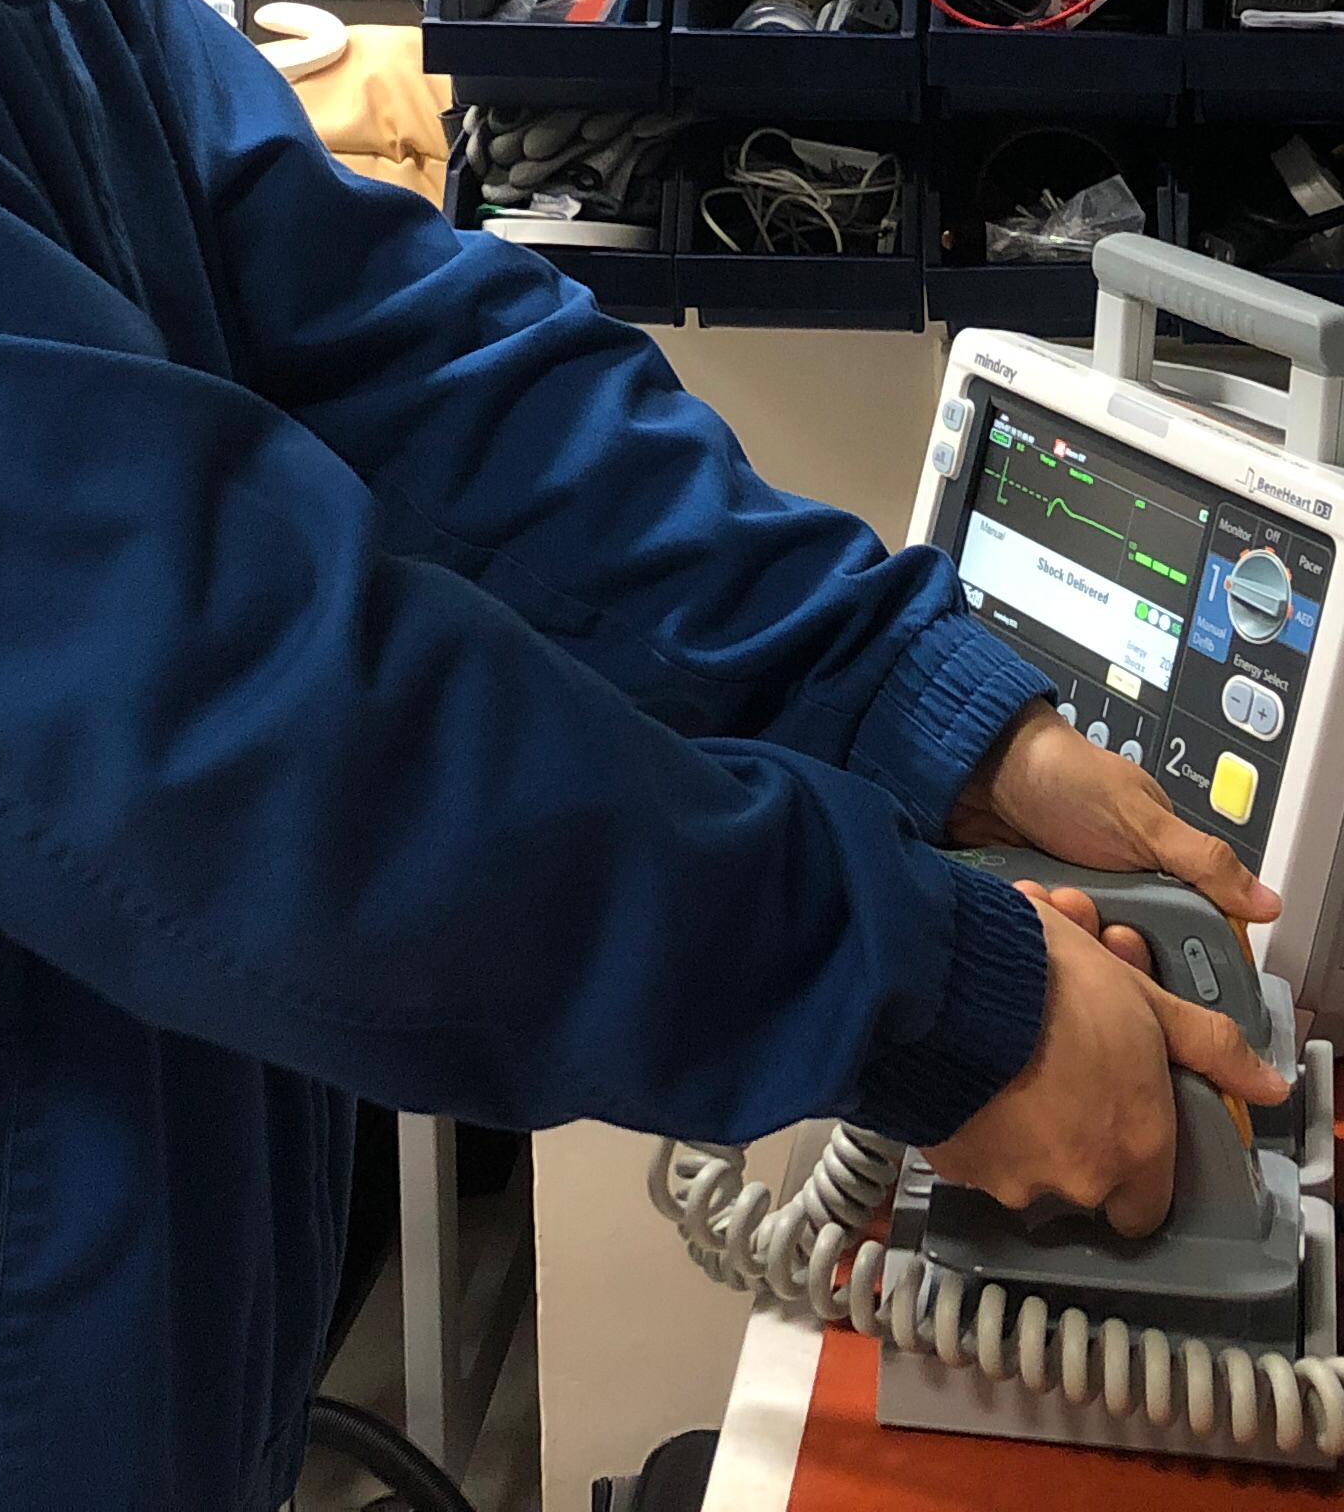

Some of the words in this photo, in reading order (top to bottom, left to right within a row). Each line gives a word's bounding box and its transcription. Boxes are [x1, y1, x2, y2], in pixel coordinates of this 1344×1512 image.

[974, 352, 1018, 385] mindray
[1257, 477, 1312, 513] BeneHeart
[1314, 500, 1332, 519] D3
[1218, 518, 1252, 542] Monitor
[1265, 528, 1281, 544] Off
[1036, 556, 1065, 582] Shock
[1066, 573, 1110, 605] Delivered
[1298, 554, 1324, 575] Pacer
[1208, 564, 1221, 602] 1
[1197, 616, 1227, 638] Manual
[1294, 610, 1315, 628] AED
[1233, 653, 1262, 680] Energy
[1263, 669, 1289, 692] Select
[1165, 737, 1186, 777] 2
[1181, 763, 1211, 788] Charge
